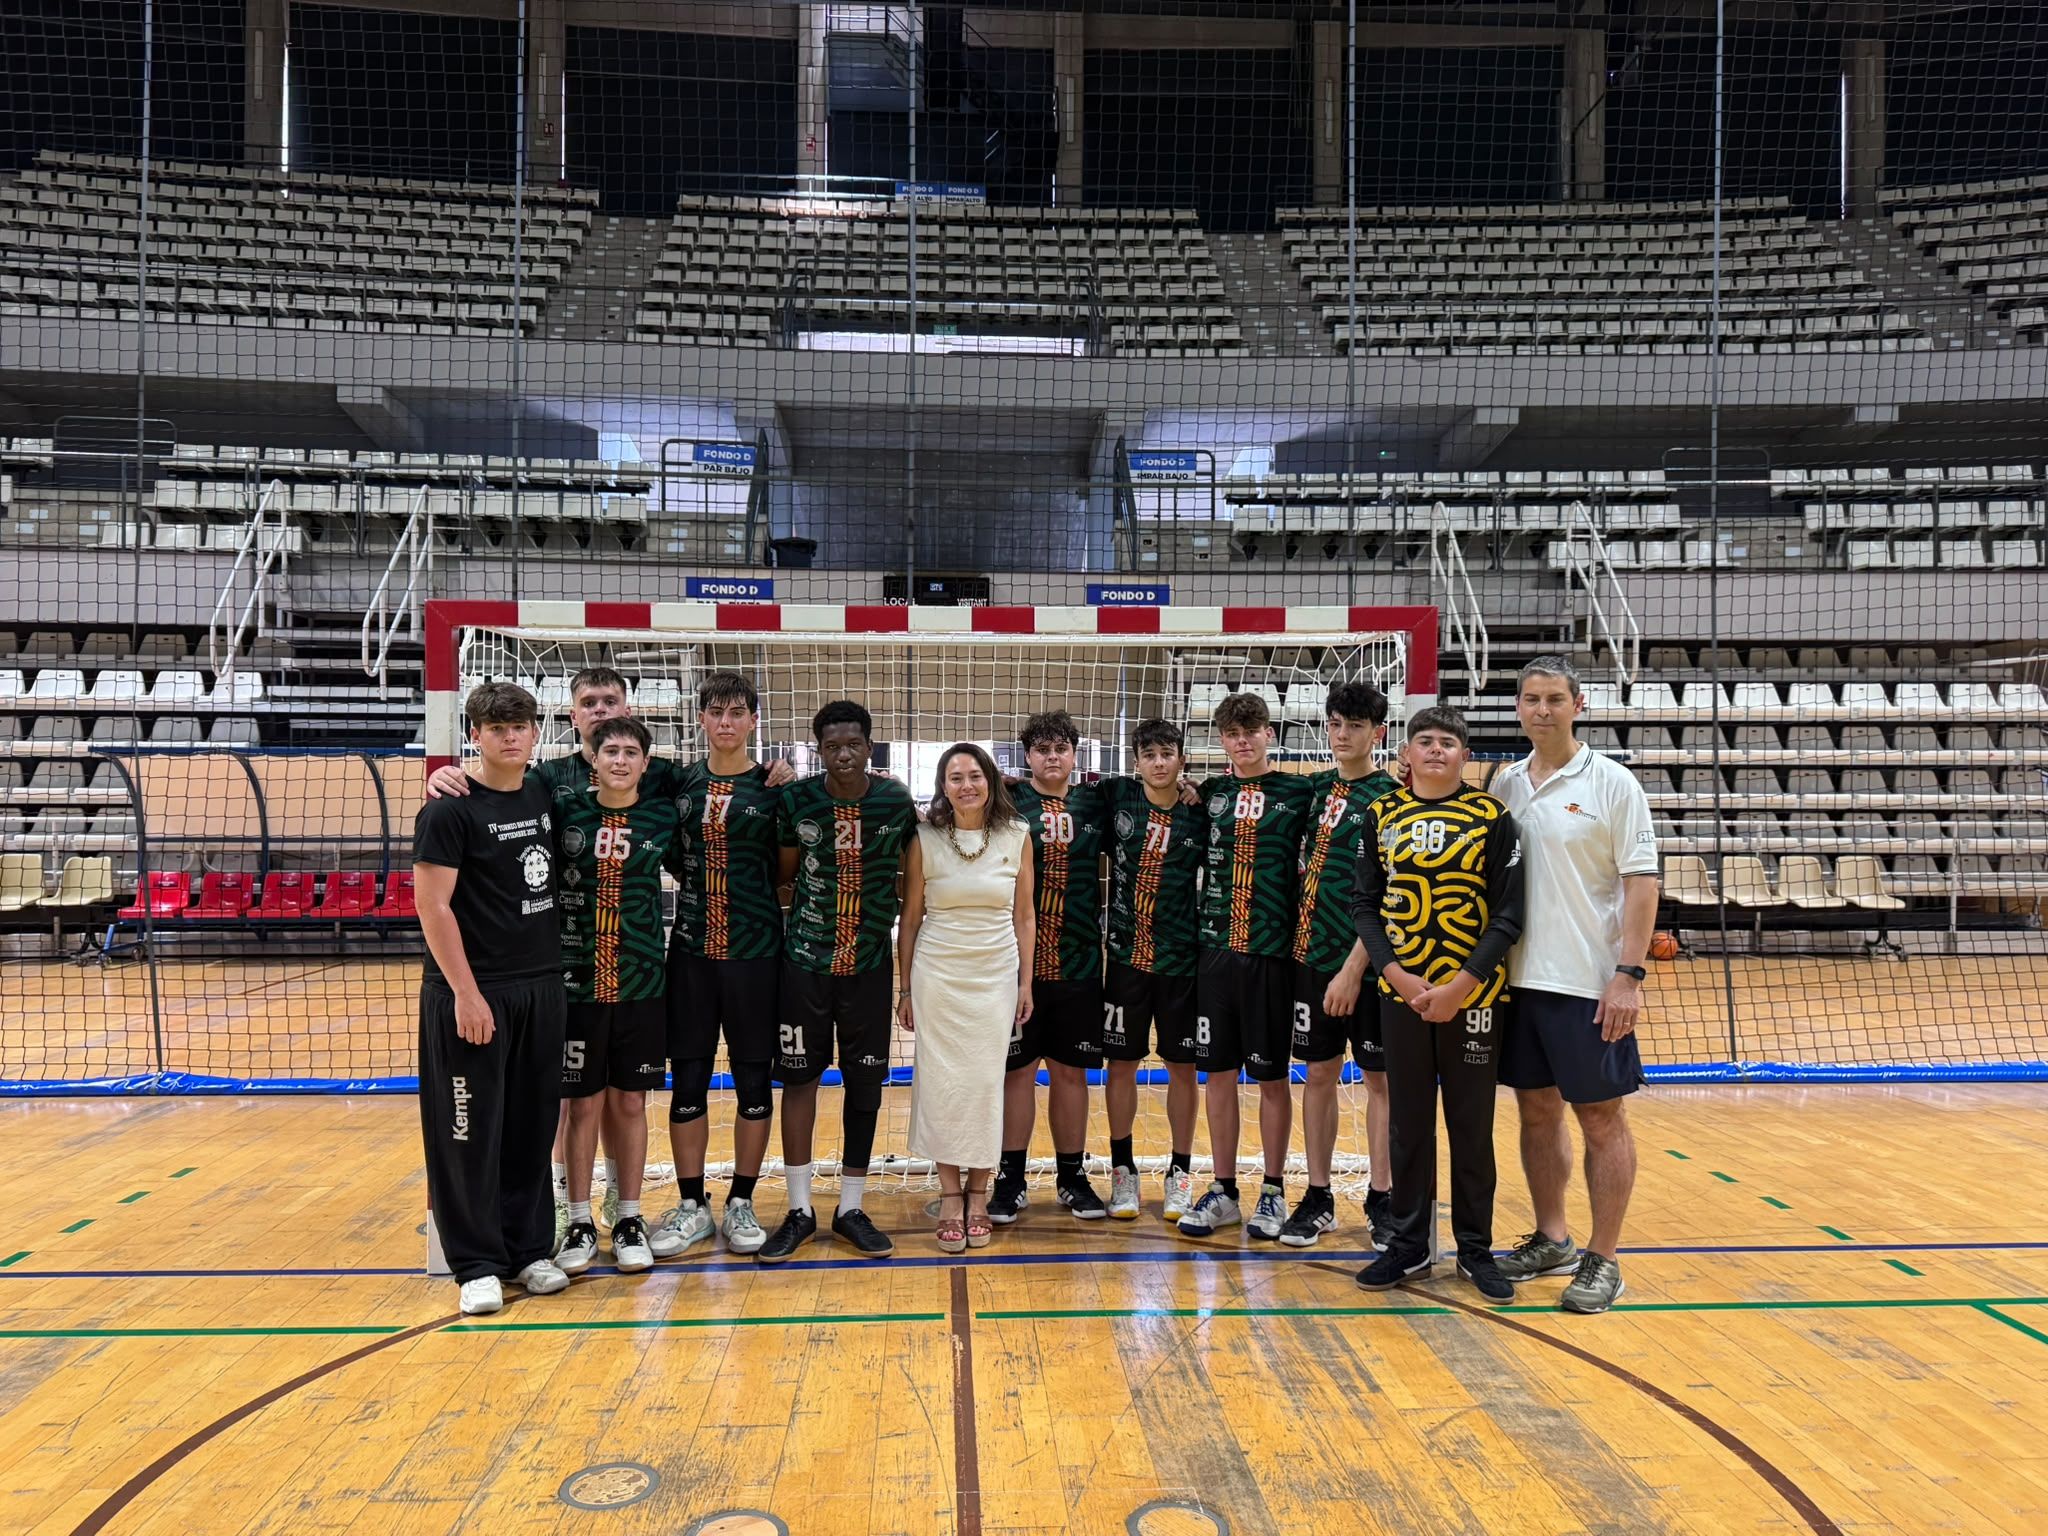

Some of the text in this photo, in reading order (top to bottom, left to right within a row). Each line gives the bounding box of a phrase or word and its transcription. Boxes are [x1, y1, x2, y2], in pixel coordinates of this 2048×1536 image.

[703, 449, 741, 460] FONDO
[1140, 457, 1186, 466] FONDO D
[703, 464, 750, 475] PAR BAJO
[701, 584, 758, 595] FONDO D
[957, 598, 987, 607] VISITANT
[1101, 591, 1155, 600] FONDO D
[701, 794, 734, 824] 17
[1233, 791, 1266, 820] 68
[834, 820, 863, 849] 21
[1039, 812, 1074, 843] 30
[1146, 821, 1171, 853] 71
[1409, 820, 1446, 853] 98
[594, 827, 632, 860] 85
[1103, 1002, 1125, 1033] 71
[1465, 1007, 1492, 1034] 98
[779, 1024, 806, 1055] 21
[452, 1076, 473, 1141] Kempa
